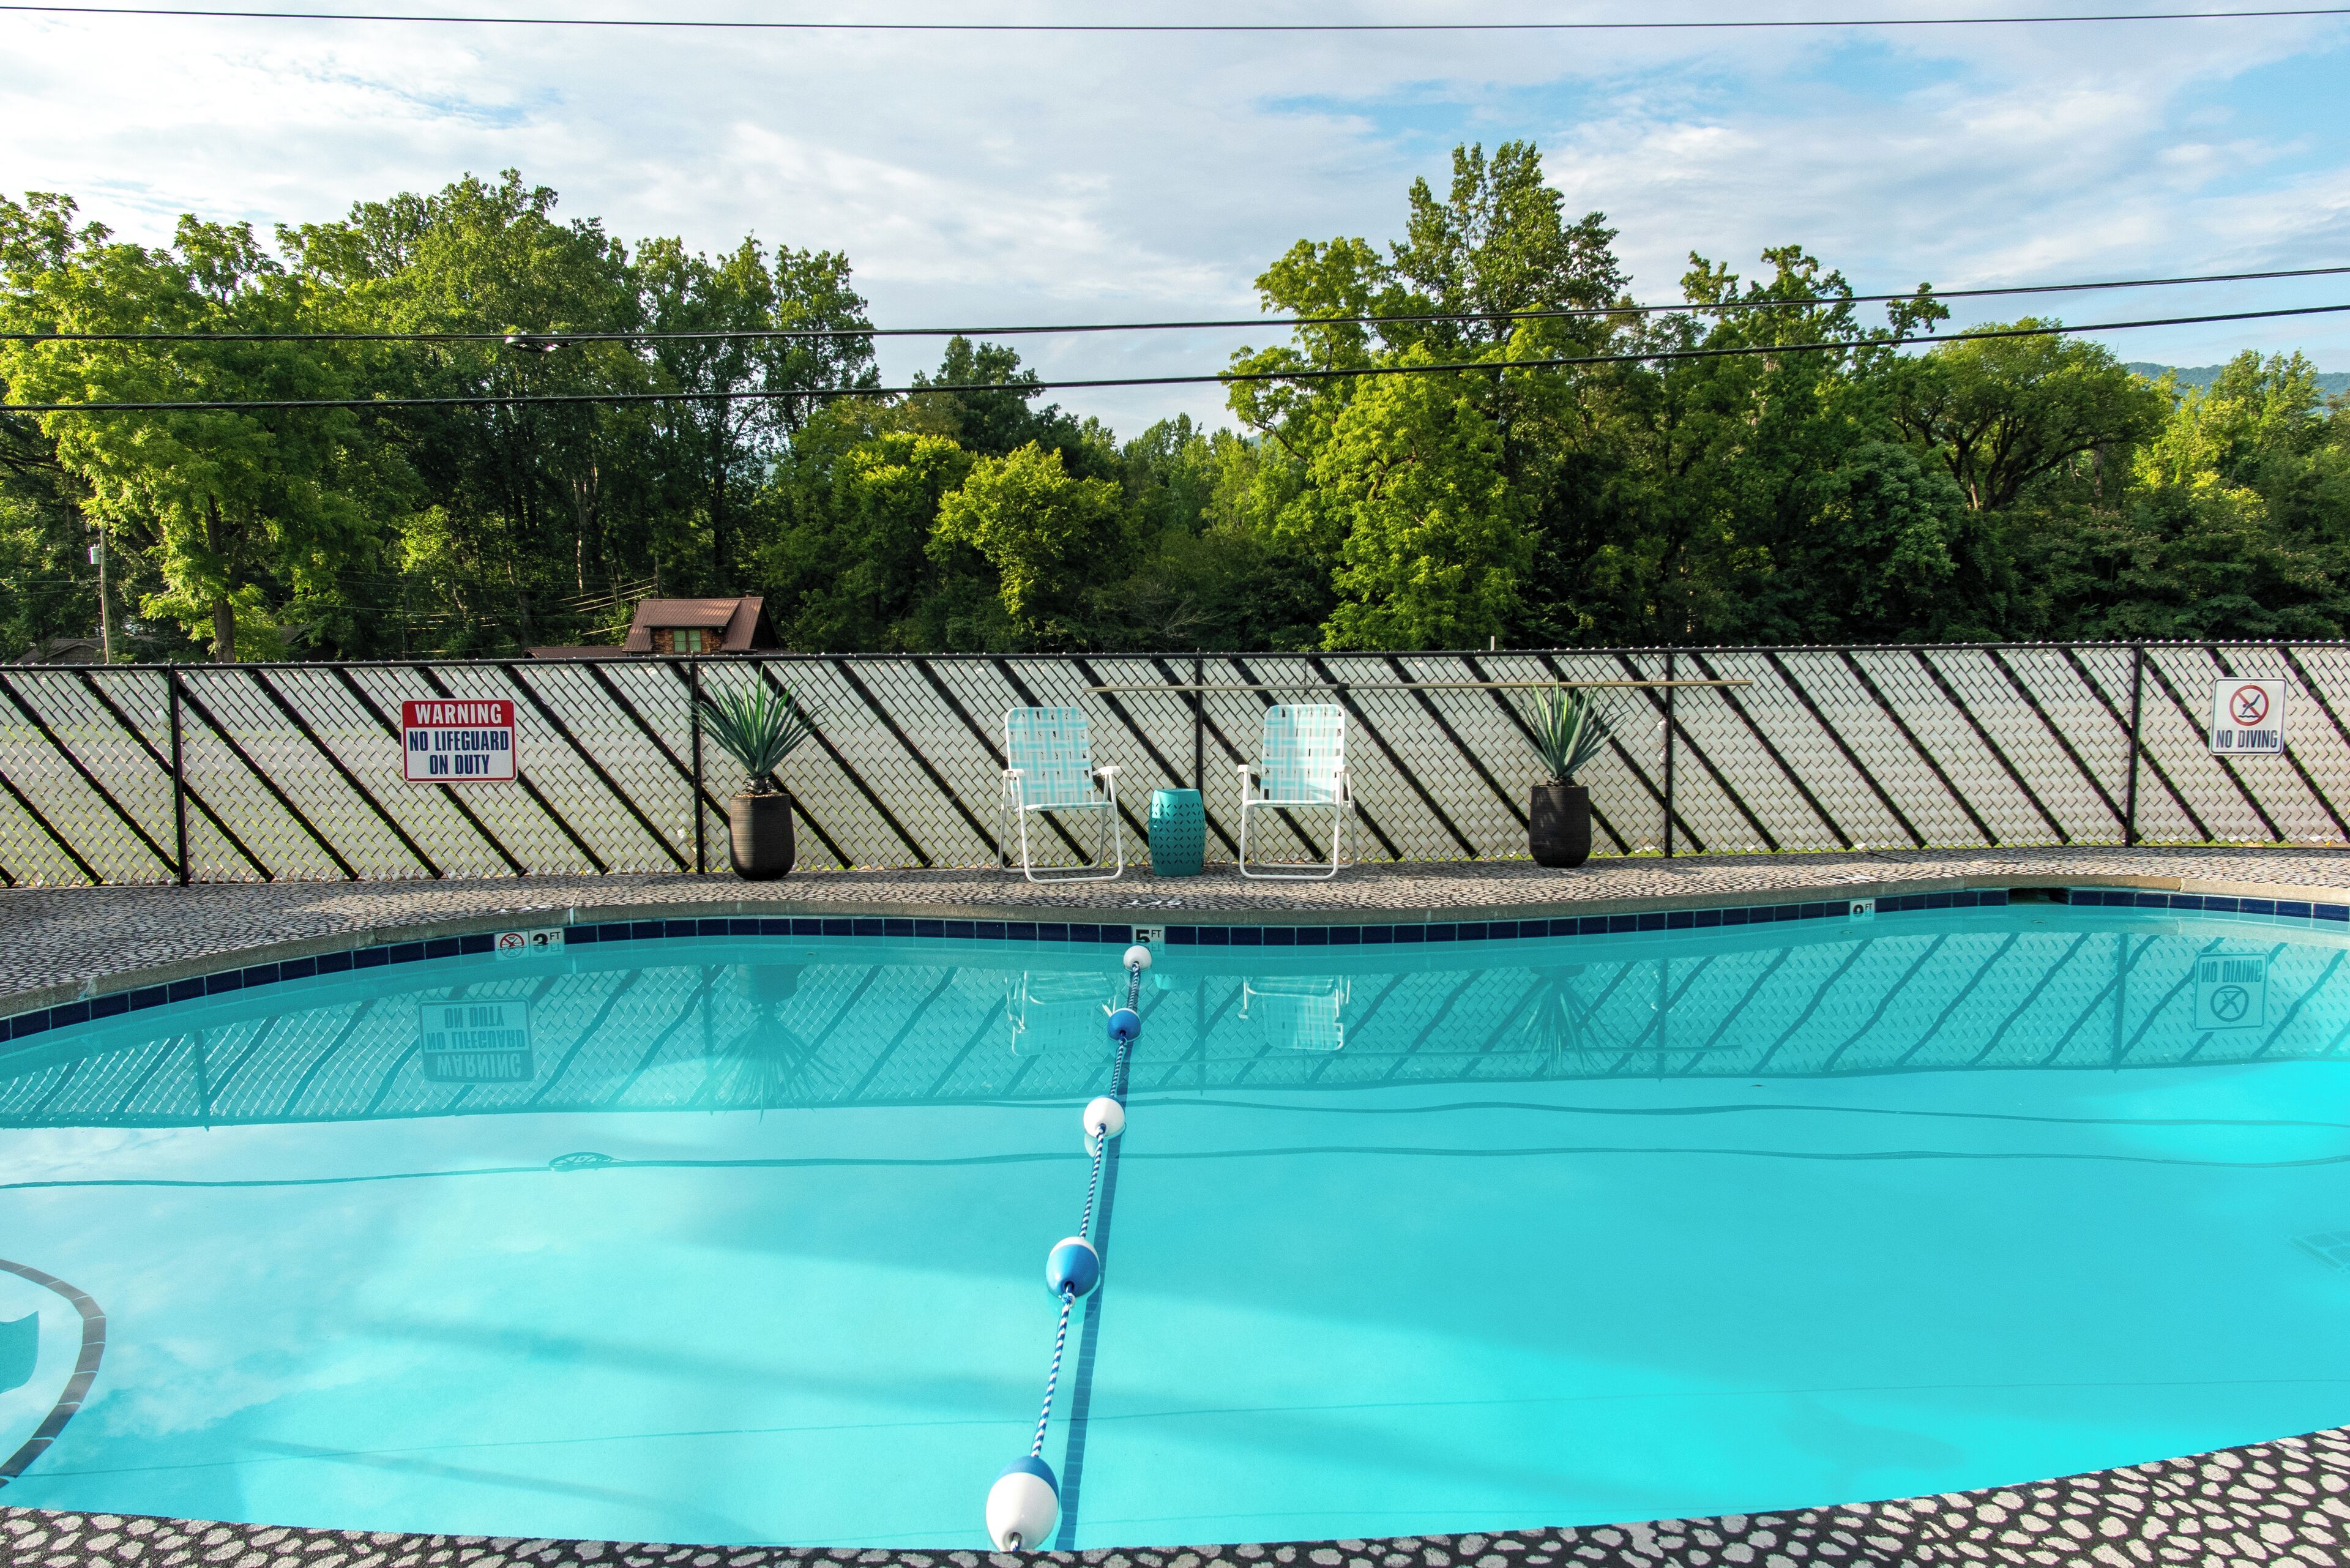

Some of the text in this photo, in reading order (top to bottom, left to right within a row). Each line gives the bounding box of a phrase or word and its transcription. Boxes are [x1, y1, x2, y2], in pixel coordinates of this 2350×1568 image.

[415, 703, 502, 725] WARNING
[409, 730, 509, 752] NO LIFEGUARD
[2215, 730, 2278, 748] NO DIVING
[429, 754, 490, 775] ON DUTY
[550, 931, 561, 940] FT
[1136, 929, 1151, 943] 5
